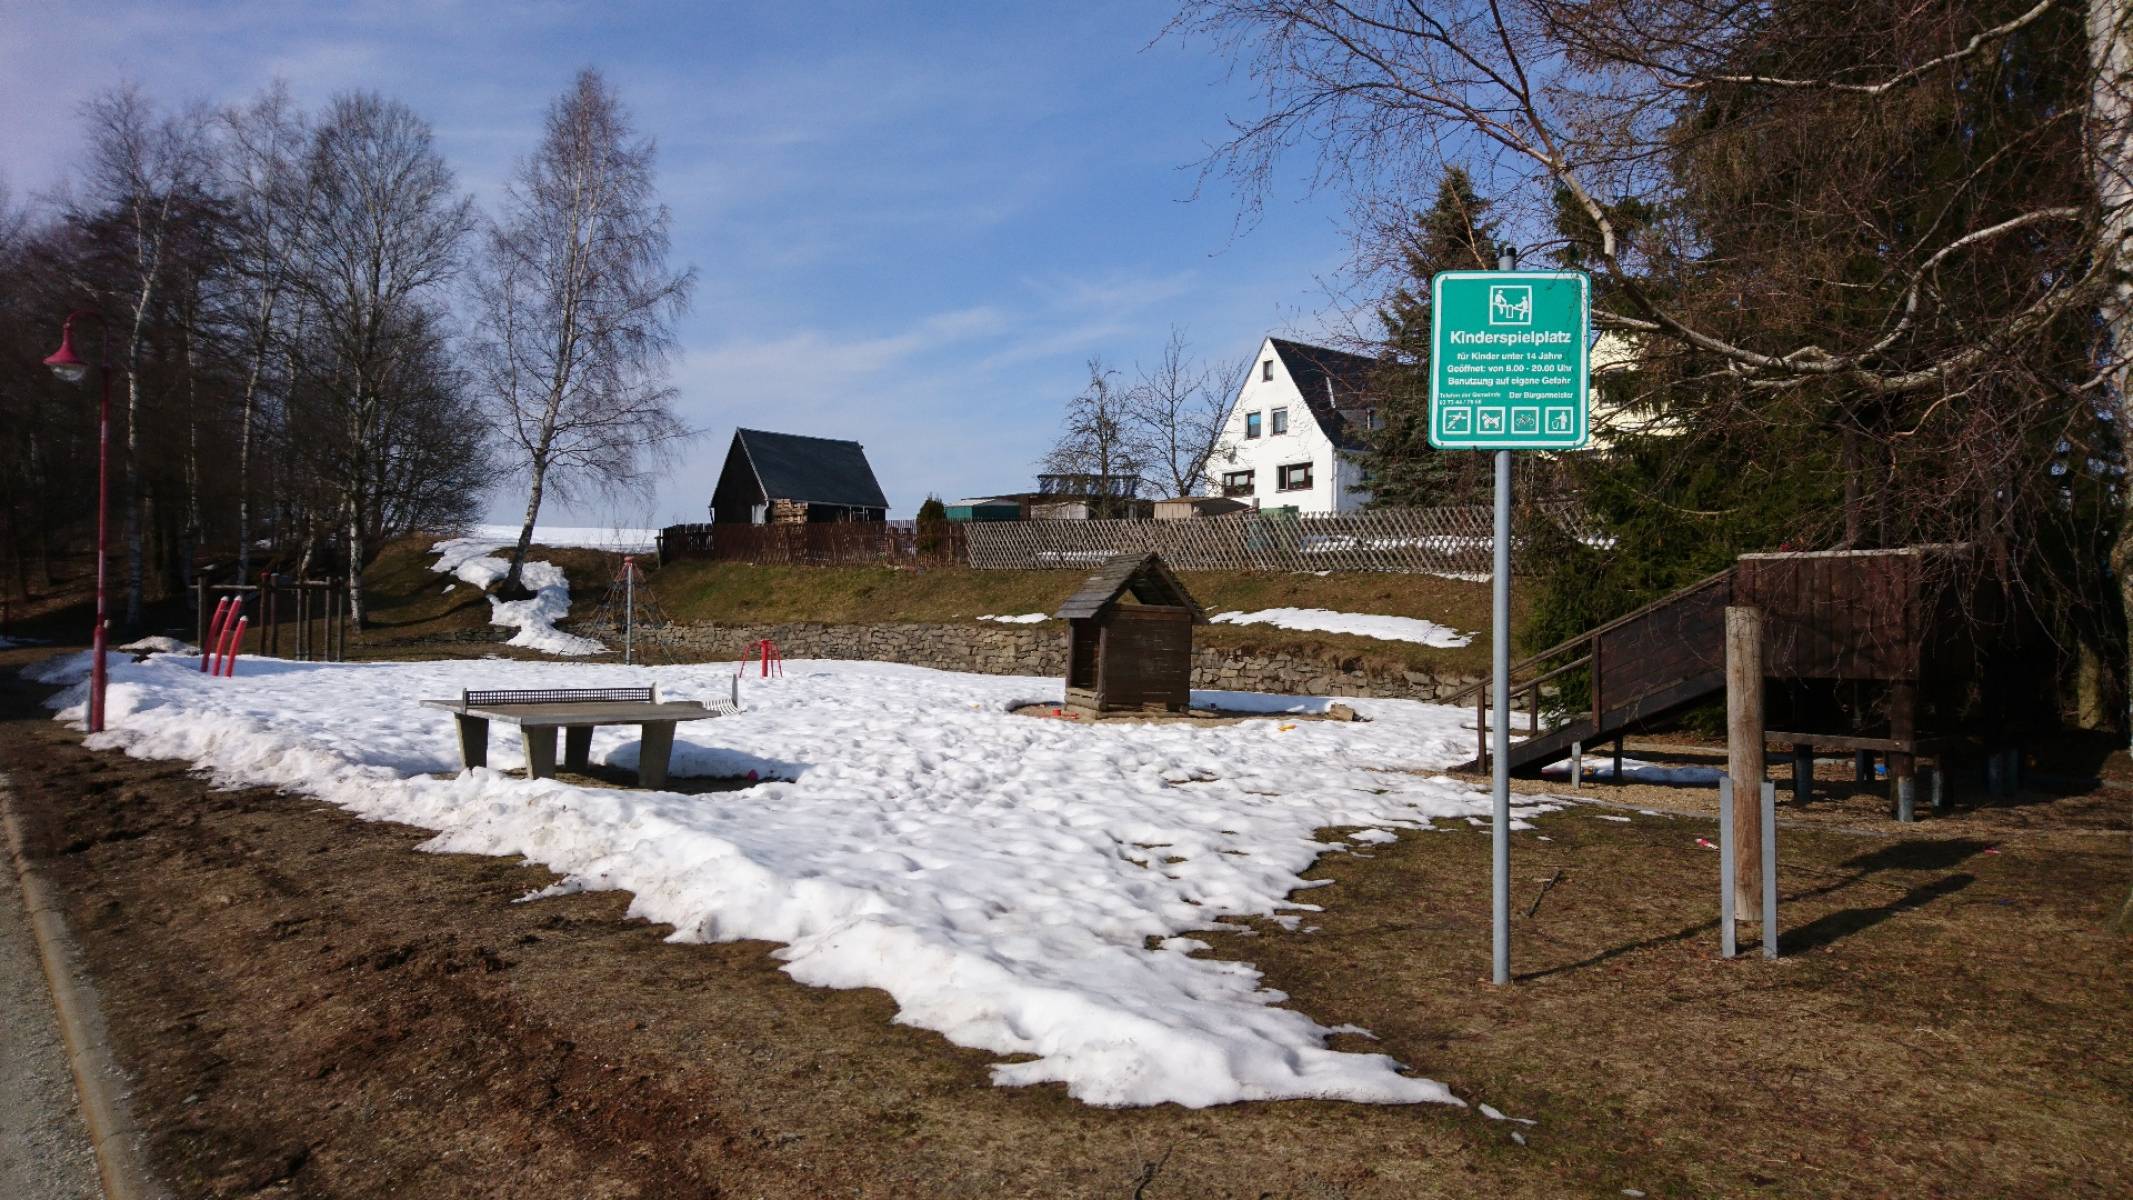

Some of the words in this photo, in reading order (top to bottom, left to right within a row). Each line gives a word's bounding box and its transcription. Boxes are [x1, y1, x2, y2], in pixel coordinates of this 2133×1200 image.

[1450, 331, 1572, 346] Kinderspielplatz
[1457, 352, 1469, 361] für
[1471, 352, 1500, 361] Kinder
[1502, 352, 1524, 361] unter
[1527, 352, 1537, 361] 14
[1538, 352, 1563, 361] Jahre
[1447, 364, 1486, 373] Geöffnet:
[1557, 364, 1572, 373] Uhr
[1448, 377, 1493, 386] Benutzung
[1495, 377, 1510, 385] auf
[1511, 378, 1540, 386] eigene
[1542, 377, 1572, 385] Gefahr
[1523, 392, 1574, 400] Bürgermeister
